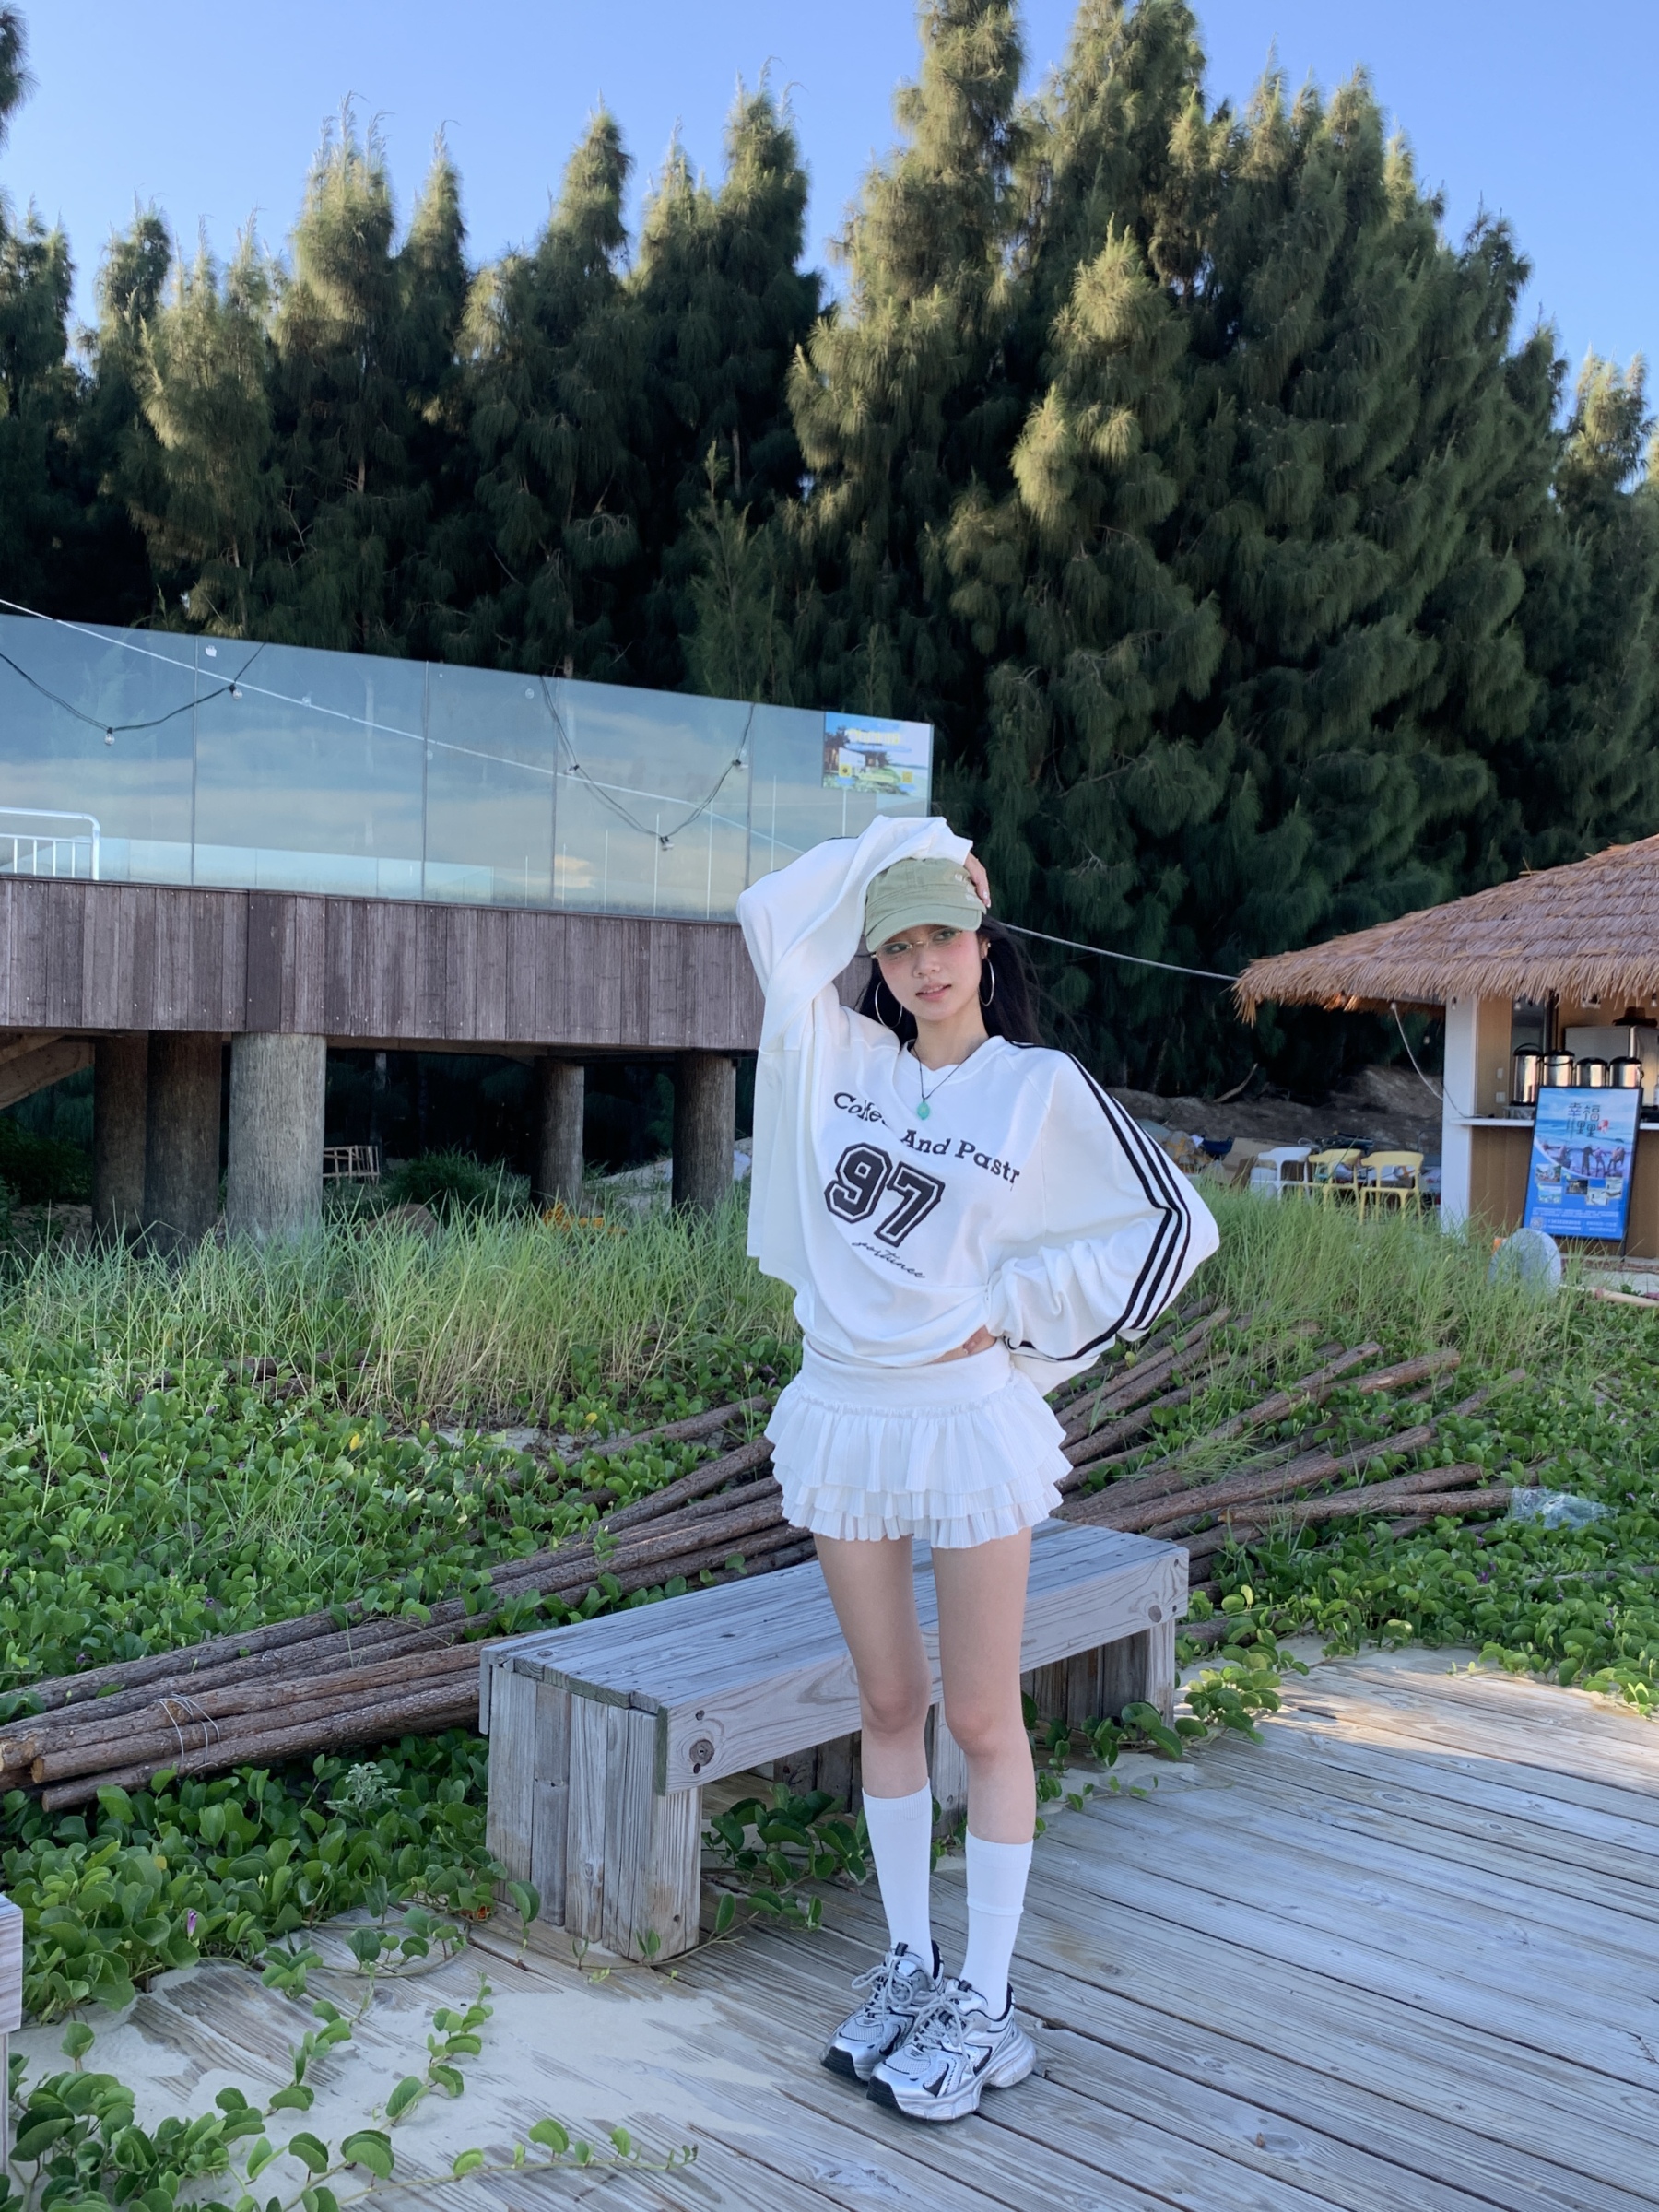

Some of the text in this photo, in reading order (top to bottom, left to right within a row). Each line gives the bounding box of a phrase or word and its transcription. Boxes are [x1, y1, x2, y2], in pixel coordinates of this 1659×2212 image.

[824, 1142, 946, 1248] 97
[900, 1129, 951, 1155] And
[955, 1139, 1020, 1191] Pastr
